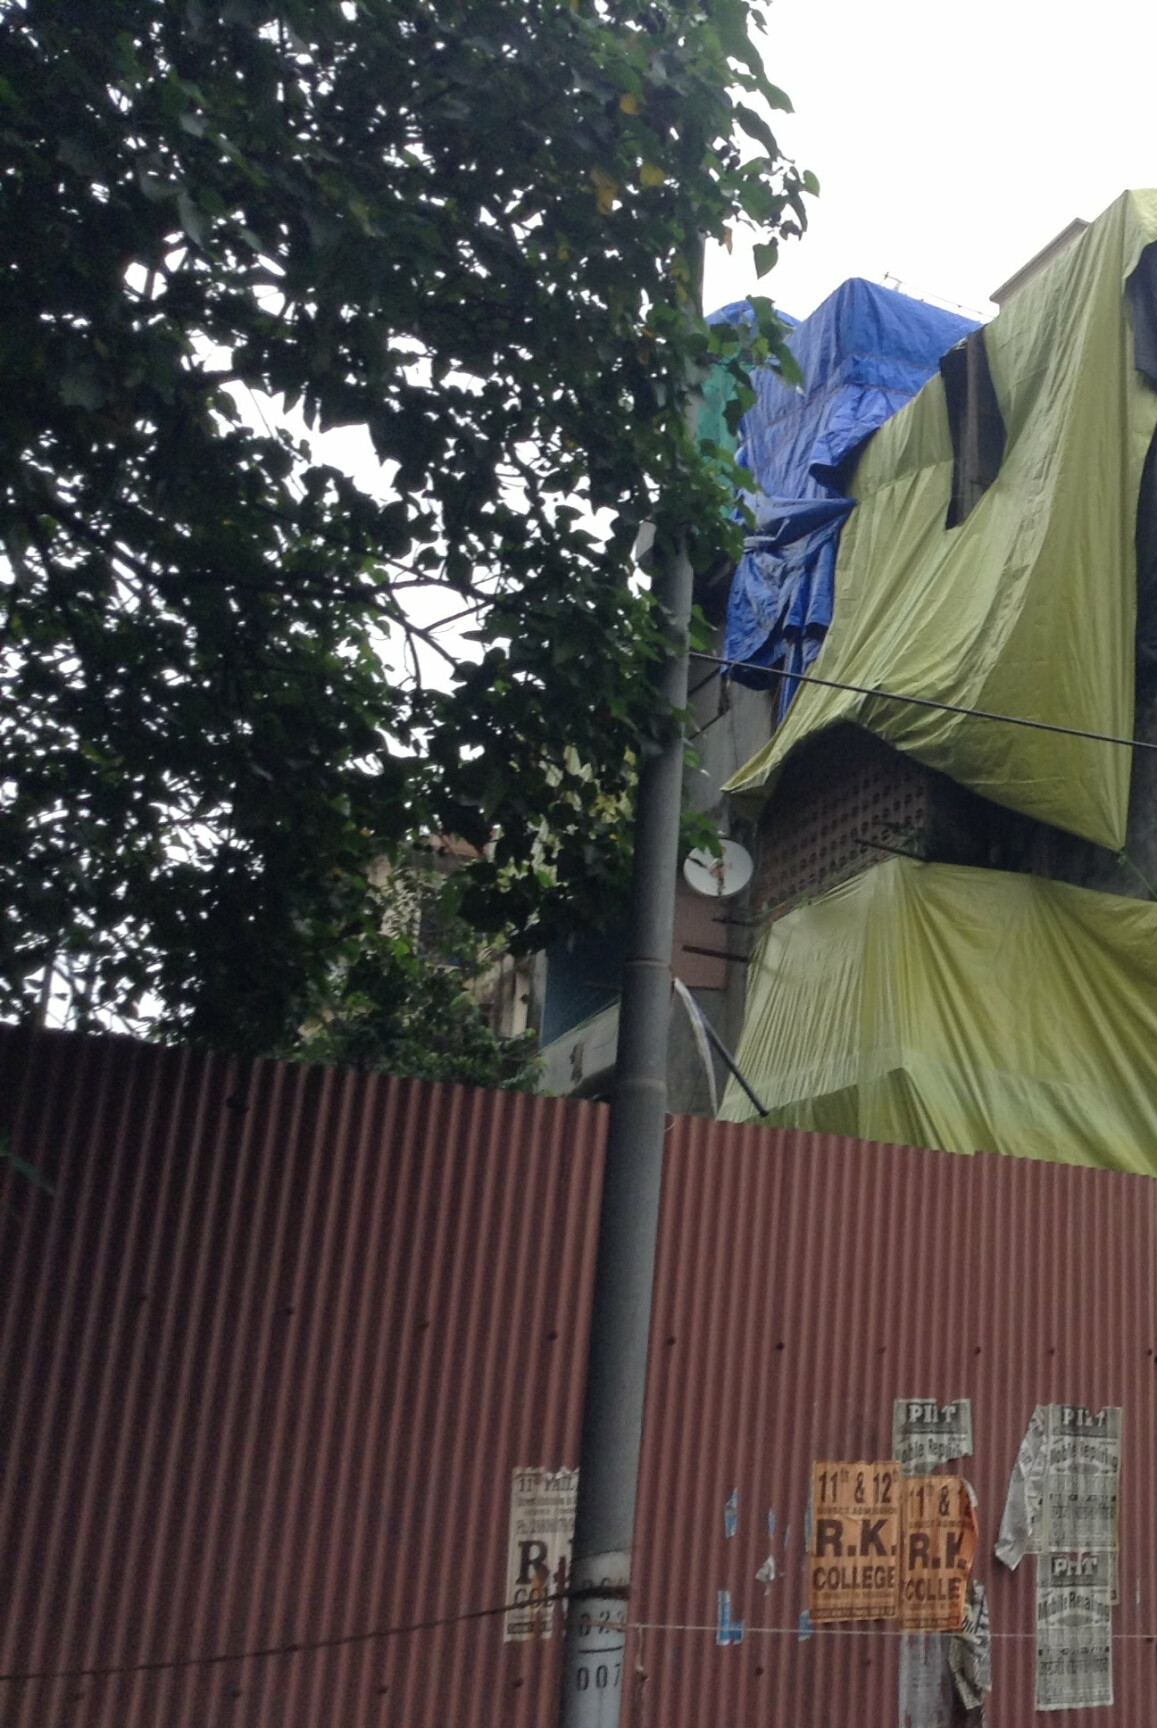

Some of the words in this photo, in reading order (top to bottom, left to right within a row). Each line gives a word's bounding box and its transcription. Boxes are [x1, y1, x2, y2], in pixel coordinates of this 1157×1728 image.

[854, 1471, 866, 1503] &
[938, 1485, 950, 1516] &
[816, 1519, 897, 1557] R.K.
[812, 1566, 896, 1591] COLLEGE
